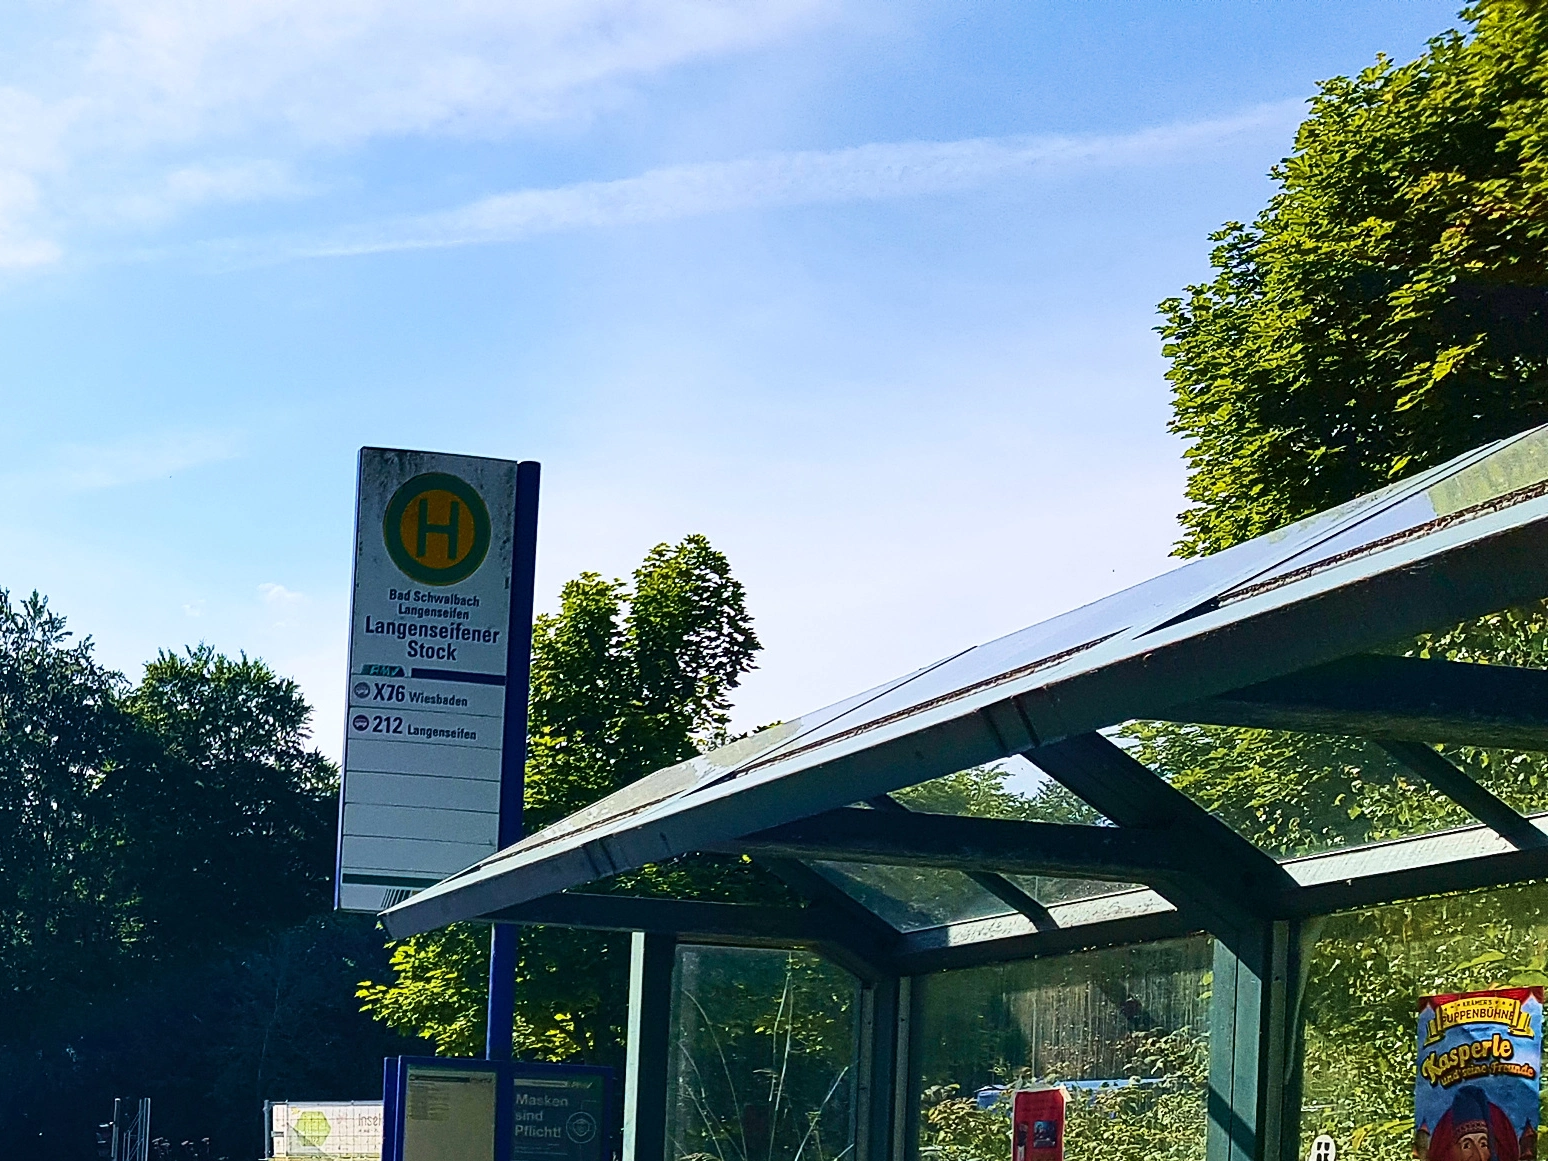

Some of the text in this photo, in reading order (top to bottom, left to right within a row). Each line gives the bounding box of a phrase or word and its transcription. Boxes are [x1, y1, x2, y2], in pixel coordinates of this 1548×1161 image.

[416, 498, 460, 560] H
[389, 588, 480, 607] Bad Schwalbach
[398, 603, 470, 620] Langenseifen
[365, 615, 500, 643] Langenseifener
[407, 640, 457, 661] Stock
[372, 682, 468, 707] X76 Wiesbaden
[372, 715, 477, 741] 212 Langenseifen
[1421, 1033, 1513, 1086] Kasperle
[1491, 1061, 1535, 1079] Freunde
[515, 1093, 569, 1107] Masken
[515, 1110, 544, 1121] sind
[515, 1124, 562, 1138] Pflicht!
